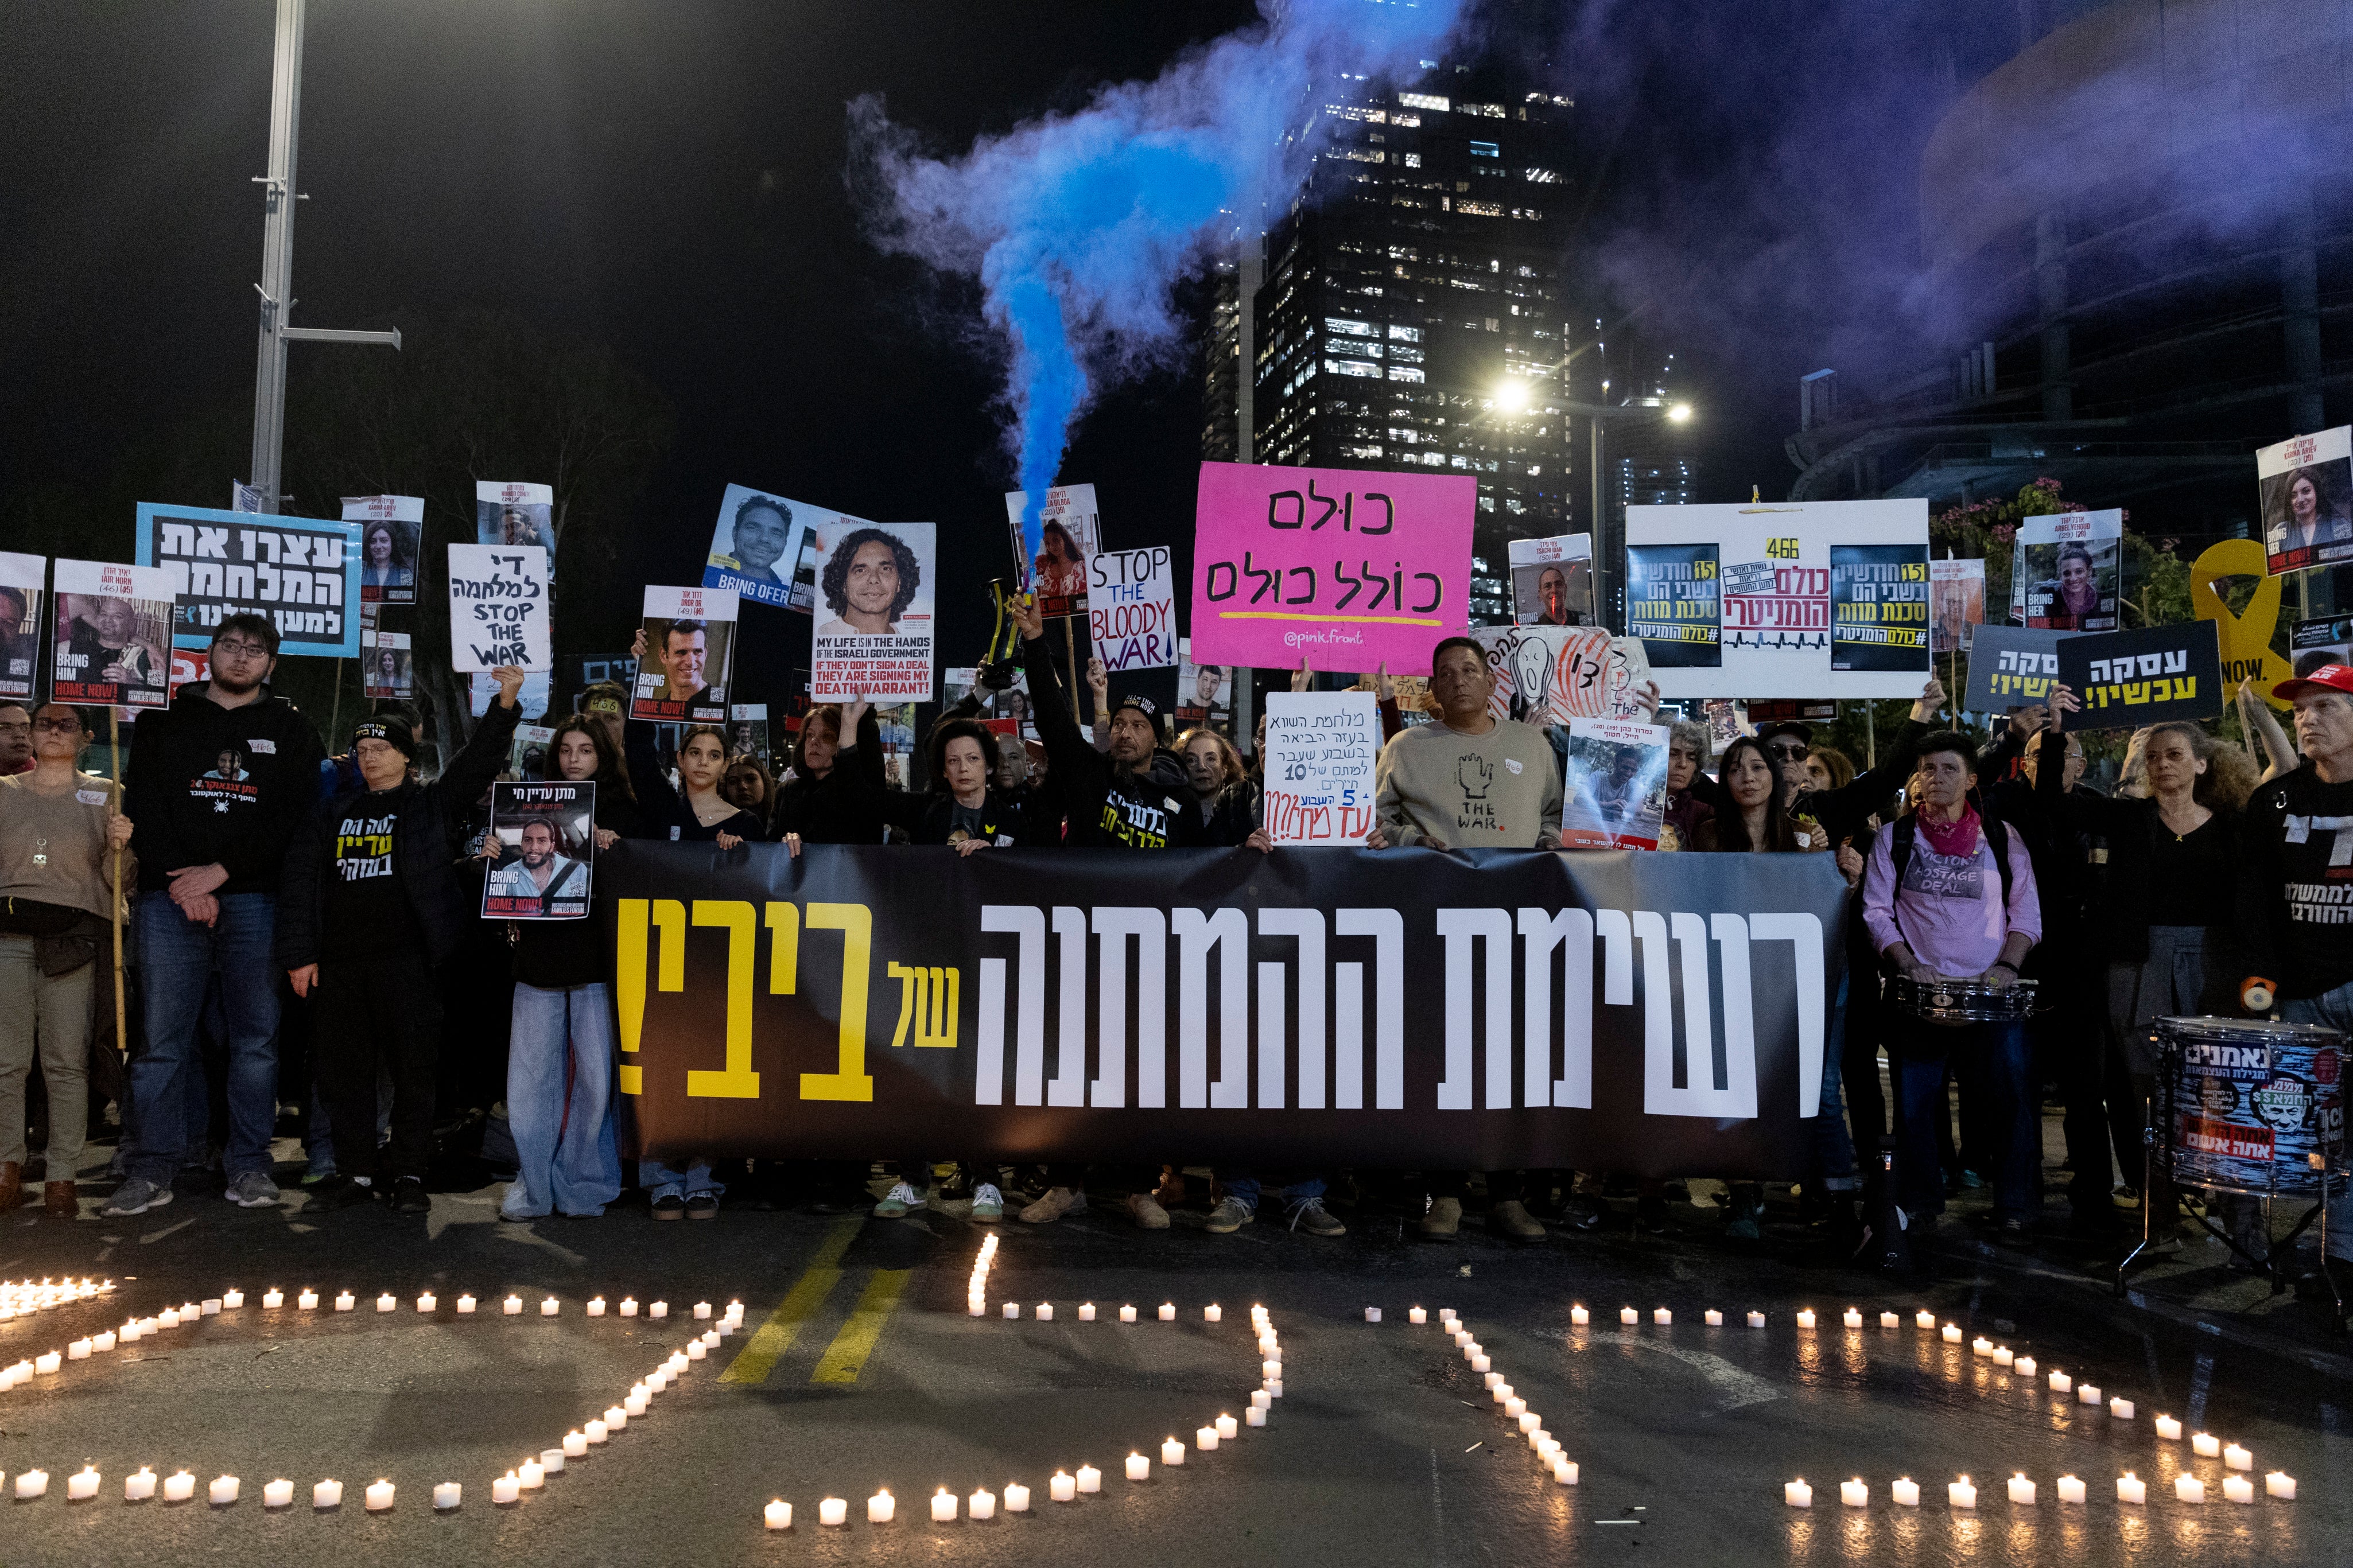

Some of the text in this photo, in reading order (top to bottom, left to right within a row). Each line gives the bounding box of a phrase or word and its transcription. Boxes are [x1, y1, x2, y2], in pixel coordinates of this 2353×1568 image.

[2302, 445, 2317, 455] ARIEV
[1054, 498, 1070, 507] GILBOA
[2267, 527, 2287, 543] BRING
[161, 523, 343, 568] עצרו את
[1767, 538, 1799, 559] 466
[2268, 542, 2280, 555] HER
[491, 554, 525, 575] די
[1092, 548, 1168, 588] STOP
[1696, 562, 1713, 580] 15
[1750, 563, 1766, 572] נשות
[102, 575, 132, 585] IAIR HORN
[1739, 574, 1761, 582] בריאות
[1776, 566, 1829, 594] כולם
[1902, 565, 1921, 582] 15
[452, 573, 540, 599] למלחמה
[718, 574, 790, 604] BRING OFER
[1107, 582, 1144, 602] THE
[1648, 581, 1717, 600] בשבי הם
[1729, 579, 1773, 593] למען החטופים
[1852, 583, 1926, 602] בשבי הם
[790, 593, 807, 605] HIM
[2028, 593, 2053, 605] BRING
[473, 602, 534, 621] STOP
[1517, 612, 1539, 624] BRING
[1634, 601, 1717, 618] סכנת מוות
[1724, 600, 1828, 627] הומניטרי
[1838, 602, 1926, 621] סכנת מוות
[2028, 605, 2044, 616] HER
[274, 609, 341, 637] למען
[1092, 598, 1171, 641] BLOODY
[486, 623, 523, 641] THE
[1284, 629, 1363, 649] @pink.front
[1632, 624, 1718, 641] #כולםהומניטרי
[1835, 626, 1926, 645] #כולםהומניטרי
[817, 637, 930, 647] MY LIFE IS IN THE HANDS
[469, 642, 532, 666] WAR
[817, 649, 930, 658] OF THE ISRAELI GOVERNMENT
[1098, 632, 1172, 671] WAR!
[57, 653, 89, 668] BRING
[817, 661, 929, 670] IF THEY DON'T SIGN A DEAL
[1999, 651, 2059, 675] סקה
[2090, 649, 2187, 684] עסקה
[56, 667, 76, 681] HIM
[817, 671, 929, 681] THEY ARE SIGNING MY
[2222, 658, 2267, 684] NOW.
[638, 673, 665, 687] BRING
[816, 682, 929, 694] DEATH WARRANT!
[1990, 674, 2059, 698] שיו!
[55, 682, 118, 699] HOME NOW!
[636, 686, 654, 699] HIM
[2085, 676, 2196, 709] עכשיו!
[635, 699, 685, 715] HOME NOW!
[1142, 698, 1155, 710] THEM
[1610, 703, 1639, 715] The
[1270, 708, 1364, 729] מלחמת השווא
[371, 729, 385, 737] אין
[1280, 733, 1369, 747] בעזה הביאה
[1277, 748, 1369, 762] בשבוע שעבר
[1285, 760, 1368, 781] למותם של 10
[1506, 762, 1521, 772] 466
[513, 788, 576, 801] מתן עדיין חי
[1300, 789, 1356, 806] 5 השבוע
[1463, 802, 1494, 815] THE
[339, 814, 398, 835] למה הם
[1338, 805, 1372, 839] עד
[336, 835, 393, 858] עדיין
[1592, 839, 1614, 847] להשאר
[2282, 814, 2353, 866] די
[1922, 849, 1976, 866] VICTORY
[337, 854, 393, 881] בעזה?
[1915, 867, 1977, 881] HOSTAGE
[490, 870, 519, 884] BRING
[488, 884, 508, 896] HIM
[1921, 880, 1961, 893] DEAL
[487, 898, 542, 911] HOME NOW!
[617, 898, 1825, 1119] רשימת ההמתנה של ביבי!
[2185, 1044, 2272, 1068] נאמנים
[2187, 1131, 2270, 1159] אתה אשם
